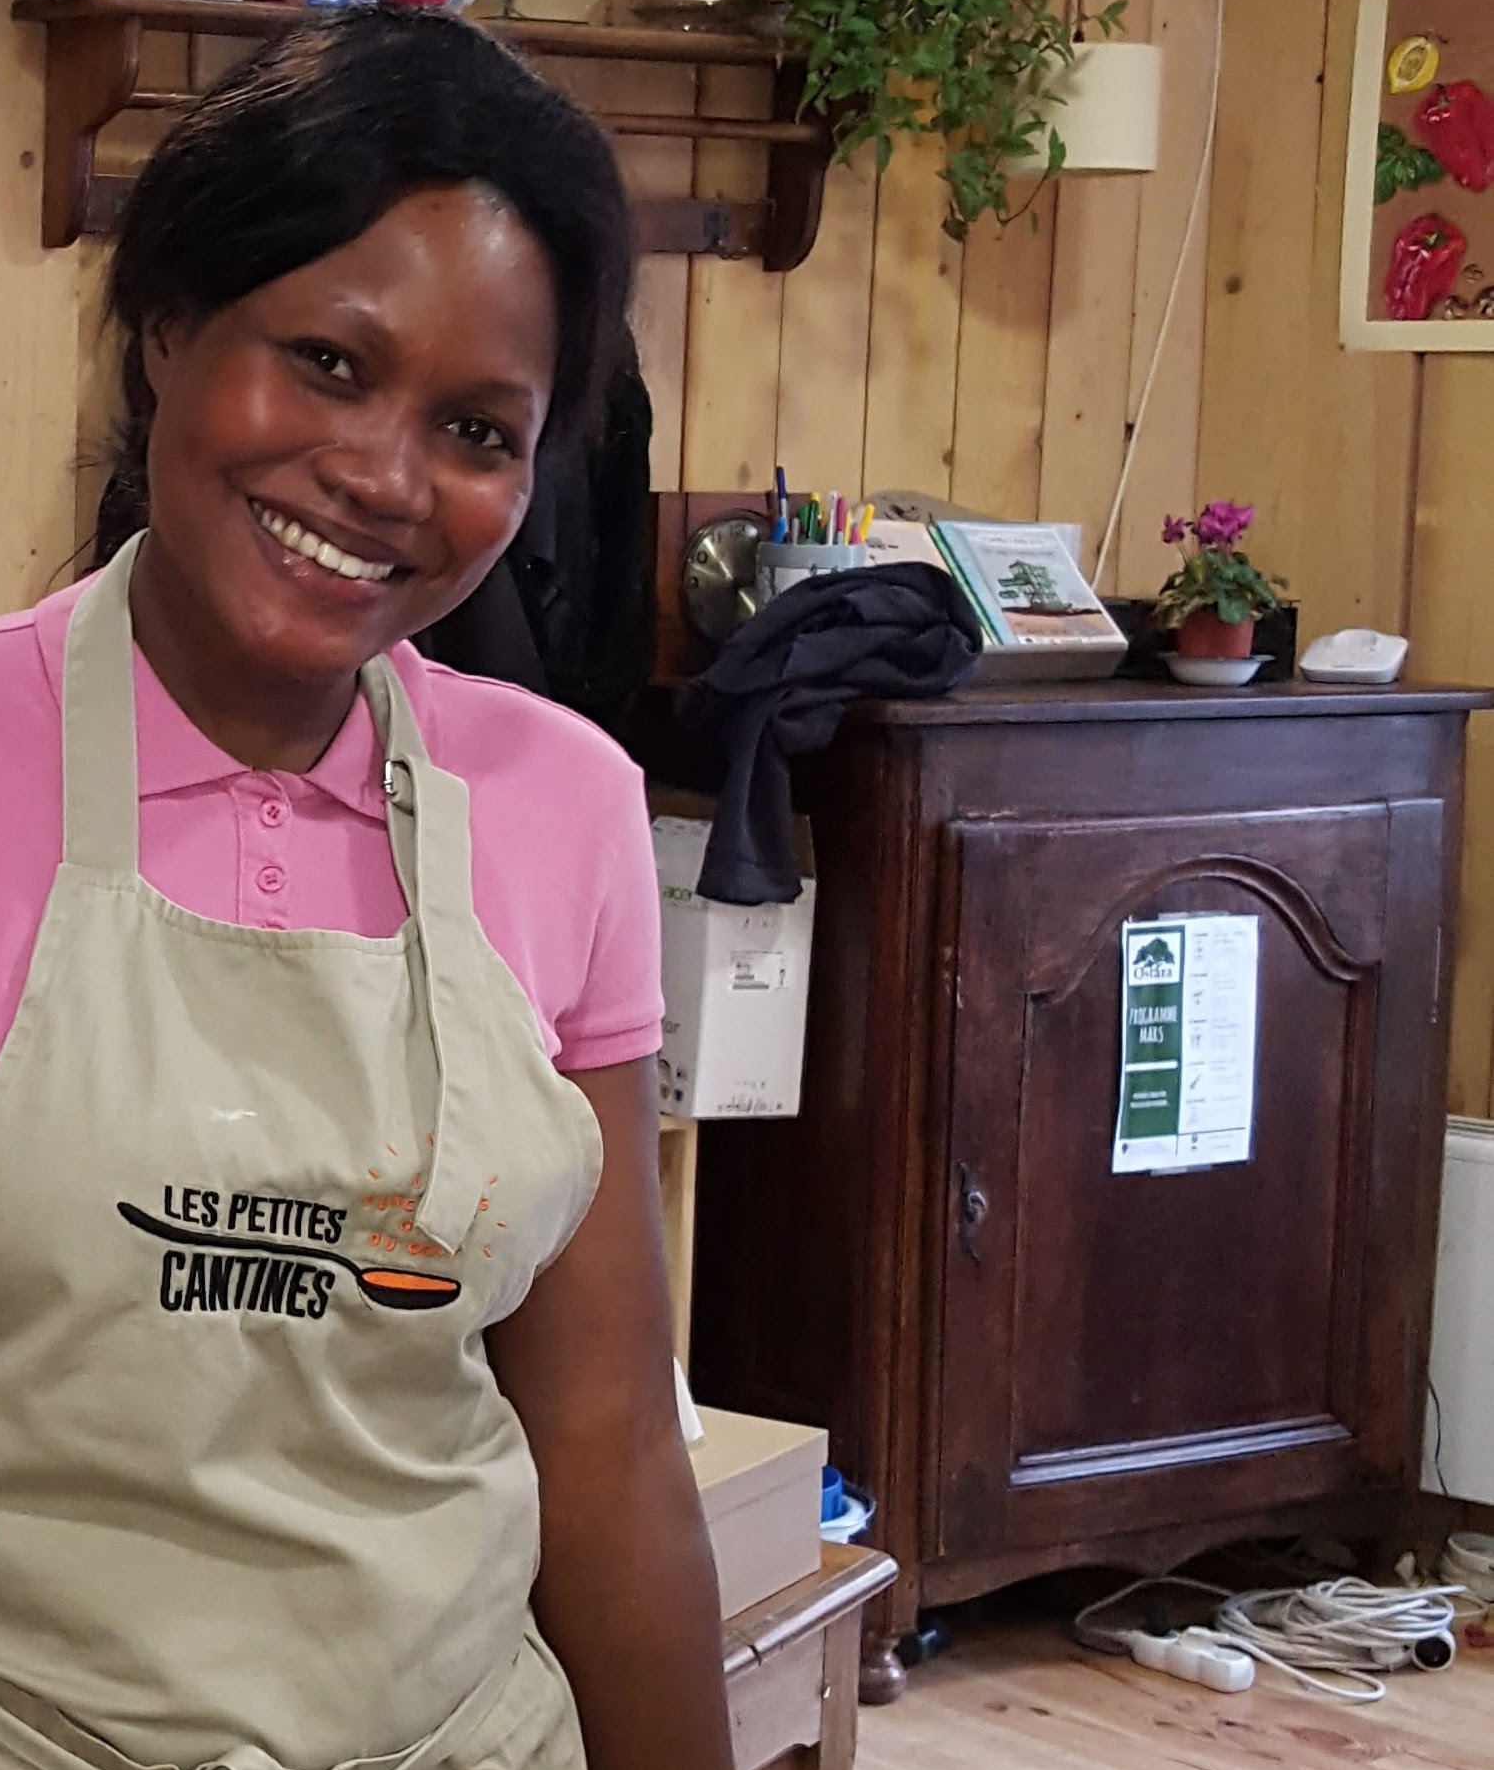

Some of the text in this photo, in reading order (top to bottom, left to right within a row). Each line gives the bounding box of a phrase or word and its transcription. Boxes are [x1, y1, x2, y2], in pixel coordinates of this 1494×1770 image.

[1133, 966, 1174, 980] Ostara
[1139, 1026, 1164, 1044] MARS
[164, 1185, 348, 1244] LES PETITES
[160, 1249, 336, 1320] CANTINES
